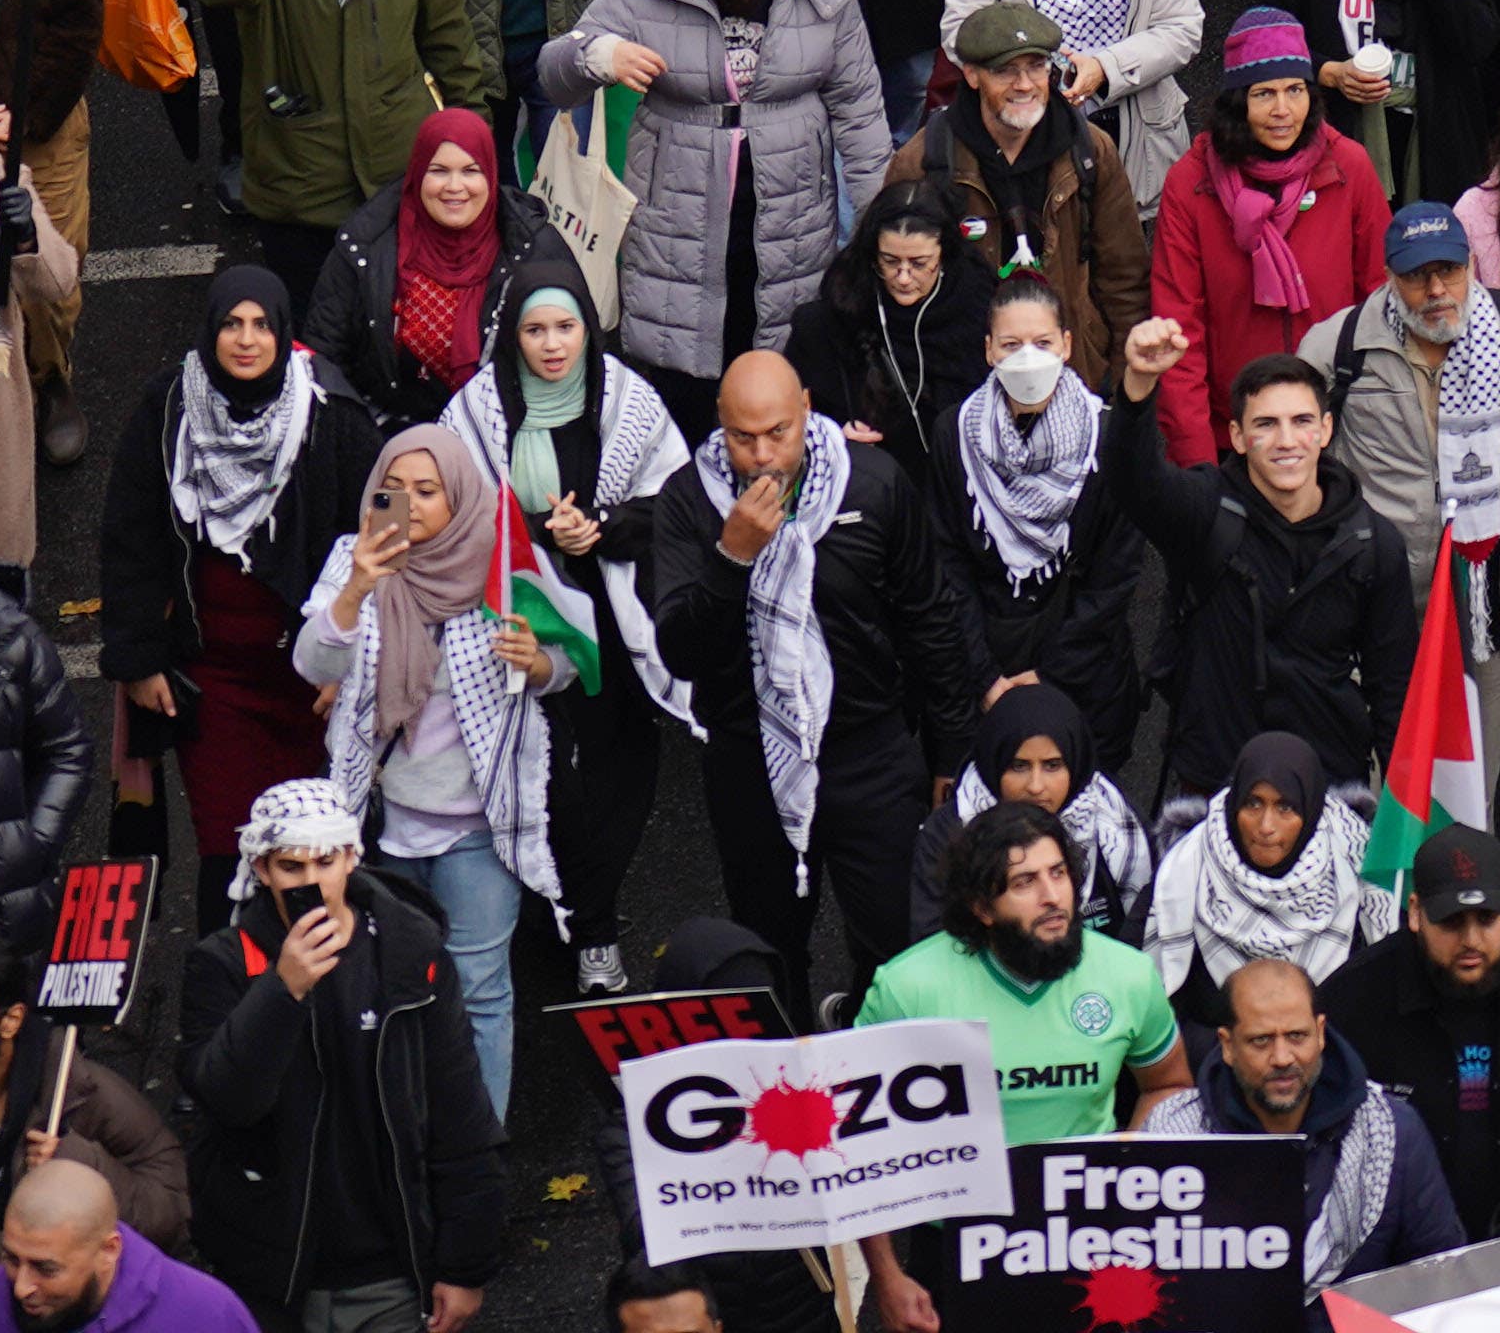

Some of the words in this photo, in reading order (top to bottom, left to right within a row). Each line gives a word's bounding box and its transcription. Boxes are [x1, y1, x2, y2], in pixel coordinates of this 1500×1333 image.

[50, 865, 145, 962] FREE
[38, 963, 127, 1006] PALESTINE
[643, 1063, 970, 1149] Gza
[1008, 1063, 1098, 1090] SMITH
[659, 1175, 735, 1210] Stop
[747, 1170, 799, 1197] the
[809, 1142, 978, 1192] massacre
[1044, 1155, 1204, 1210] Free
[961, 1217, 1290, 1280] Palestine
